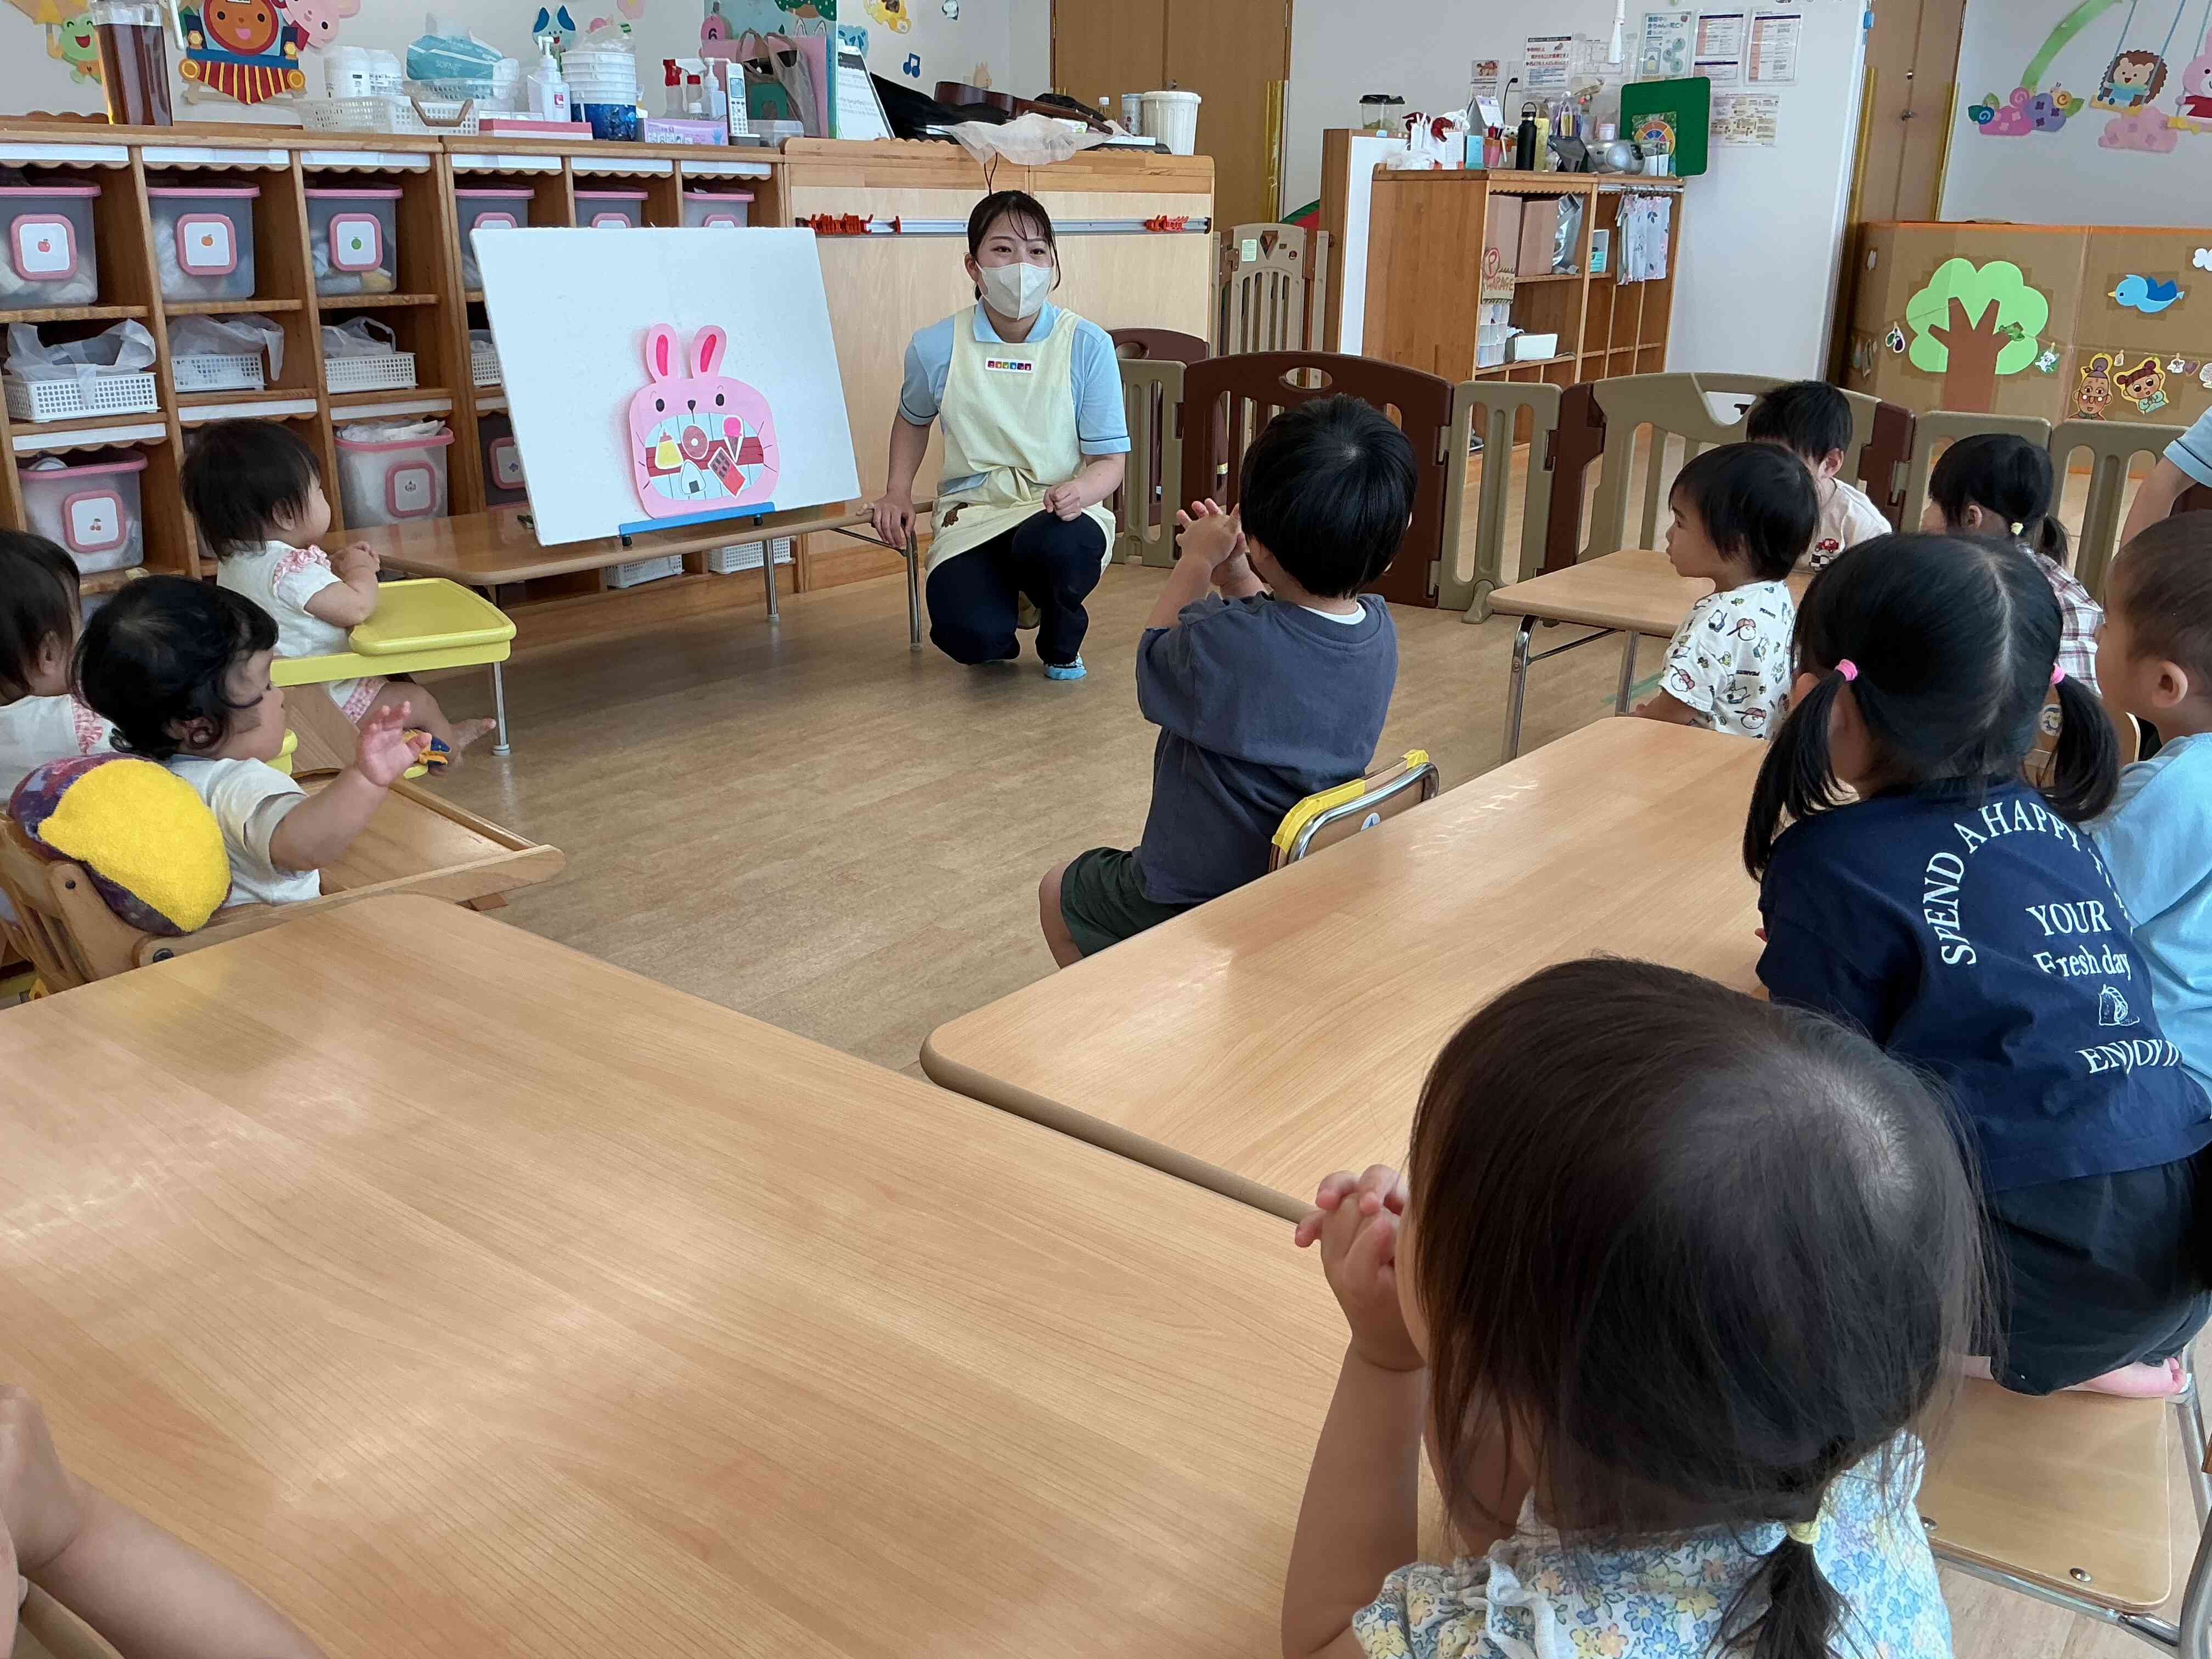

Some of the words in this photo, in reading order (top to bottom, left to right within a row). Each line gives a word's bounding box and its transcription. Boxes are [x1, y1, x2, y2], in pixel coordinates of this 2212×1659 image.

[1922, 851, 1977, 966] SPEND
[1954, 822, 1987, 854] A
[1978, 799, 2081, 852] HAPPY
[2025, 900, 2112, 936] YOUR
[2034, 946, 2100, 978] Fresh
[2102, 944, 2132, 981] day
